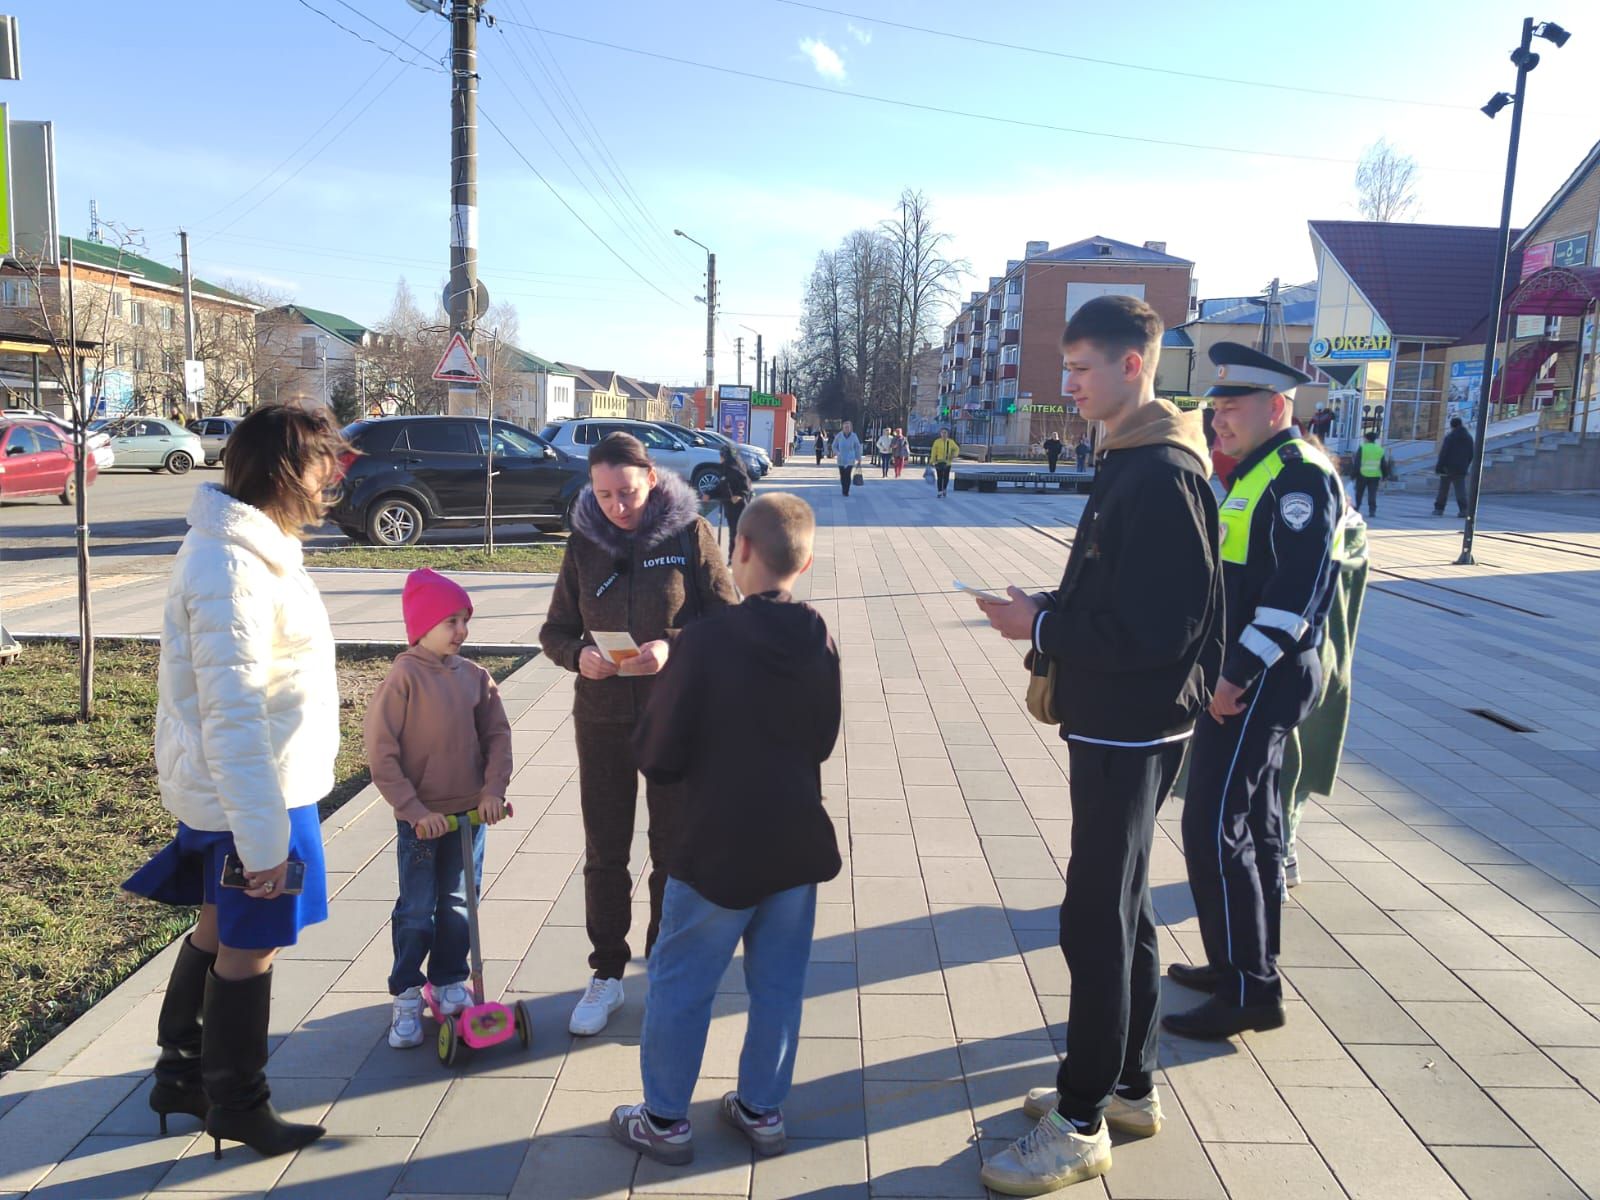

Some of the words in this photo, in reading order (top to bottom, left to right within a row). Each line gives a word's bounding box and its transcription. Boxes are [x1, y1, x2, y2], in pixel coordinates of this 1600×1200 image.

[1330, 335, 1391, 351] ОКЕАН
[1021, 404, 1064, 413] АПТЕКА
[643, 556, 665, 568] LOVE
